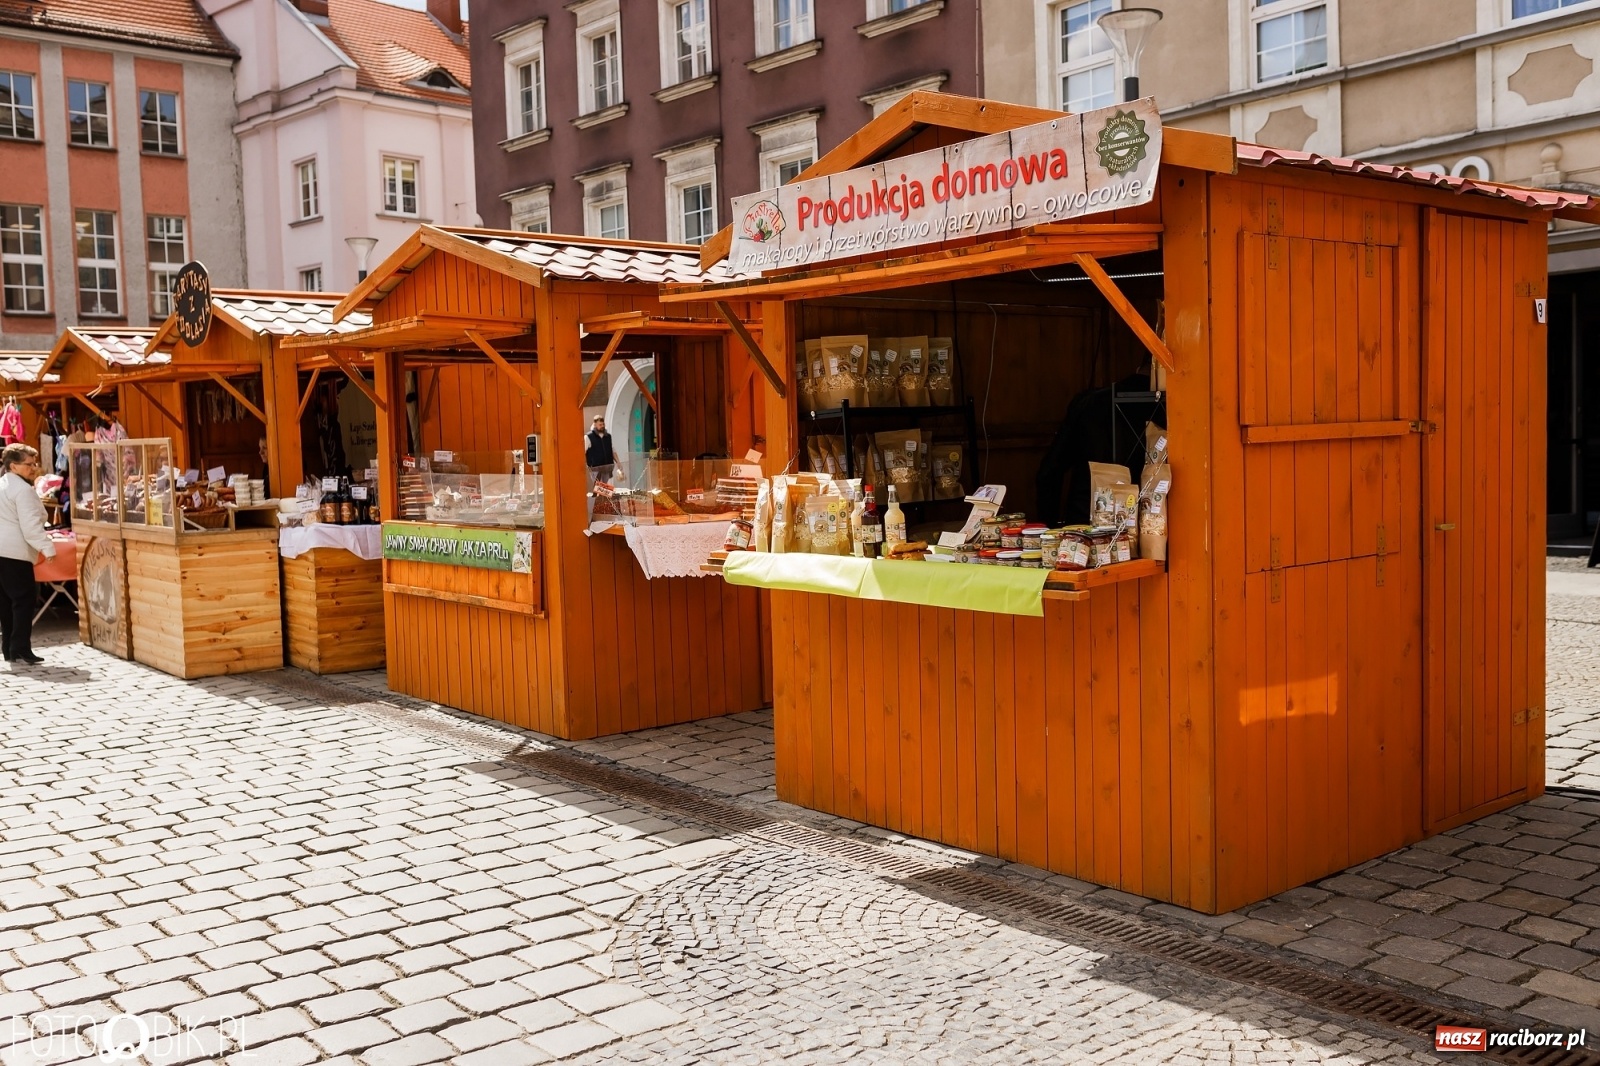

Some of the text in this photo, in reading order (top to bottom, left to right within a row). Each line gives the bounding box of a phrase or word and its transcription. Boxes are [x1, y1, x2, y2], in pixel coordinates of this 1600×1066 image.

[797, 148, 1068, 232] Produkcja domowa
[742, 242, 813, 268] makarony
[814, 236, 821, 255] i
[823, 218, 930, 258] przetwórstwo
[934, 202, 1026, 235] warzywno
[1043, 179, 1142, 214] owocowe
[1537, 302, 1543, 318] 9
[408, 535, 429, 552] SMAK
[459, 539, 475, 556] JAK
[475, 540, 487, 558] ZA
